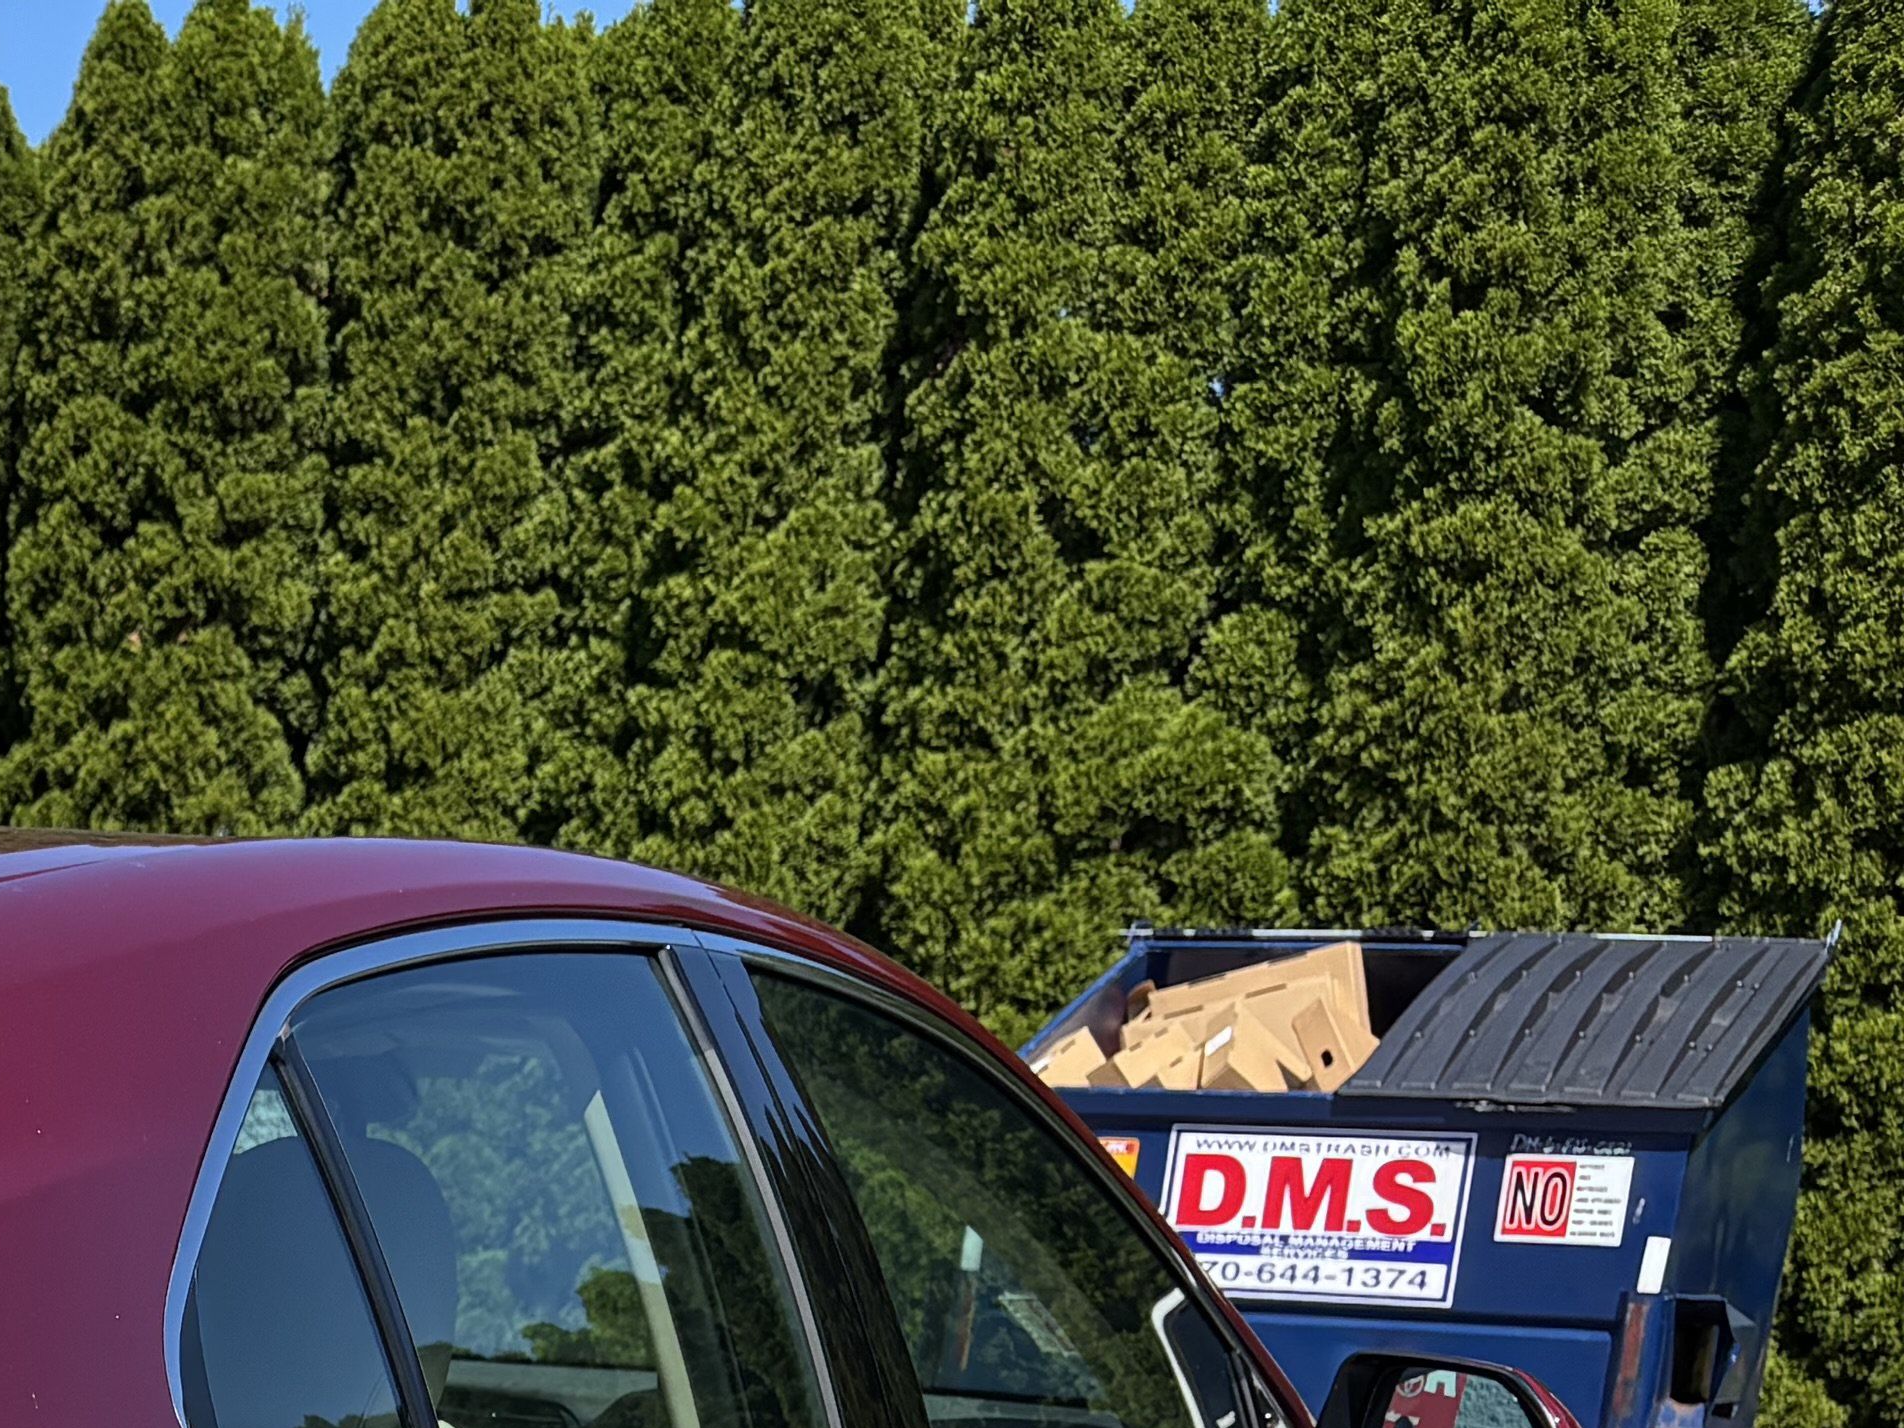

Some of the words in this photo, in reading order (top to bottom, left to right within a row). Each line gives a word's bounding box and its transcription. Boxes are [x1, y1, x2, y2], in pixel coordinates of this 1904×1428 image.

[1175, 1153, 1446, 1237] D.M.S.
[1505, 1166, 1571, 1231] NO
[1288, 1236, 1416, 1253] MANAGEMENT
